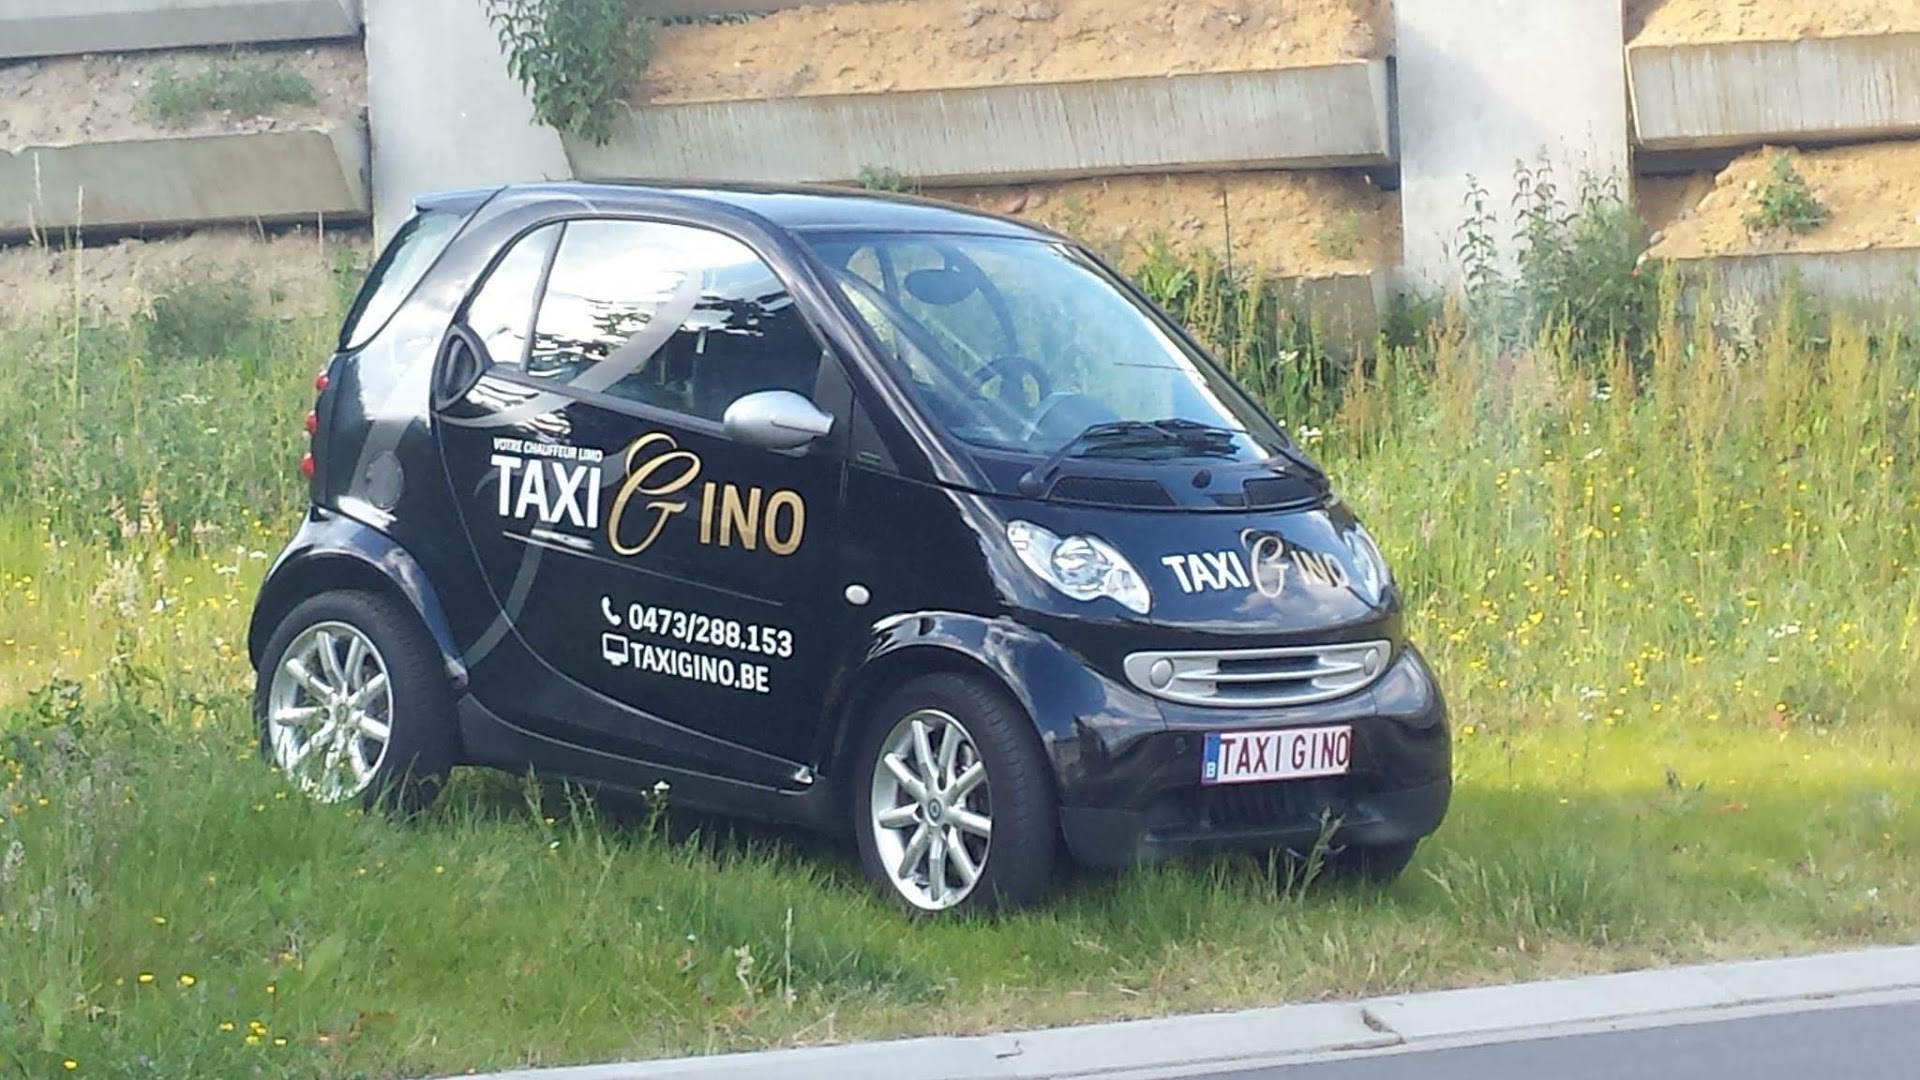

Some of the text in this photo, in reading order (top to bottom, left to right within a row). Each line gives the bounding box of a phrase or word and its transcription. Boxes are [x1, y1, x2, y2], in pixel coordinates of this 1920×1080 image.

[493, 437, 523, 453] VOTRE
[491, 454, 601, 529] TAXI
[1161, 551, 1250, 593] TAXI
[628, 603, 793, 658] 0473/288.153
[630, 641, 770, 693] TAXIGINO.BE
[1220, 731, 1350, 775] TAXI GINO
